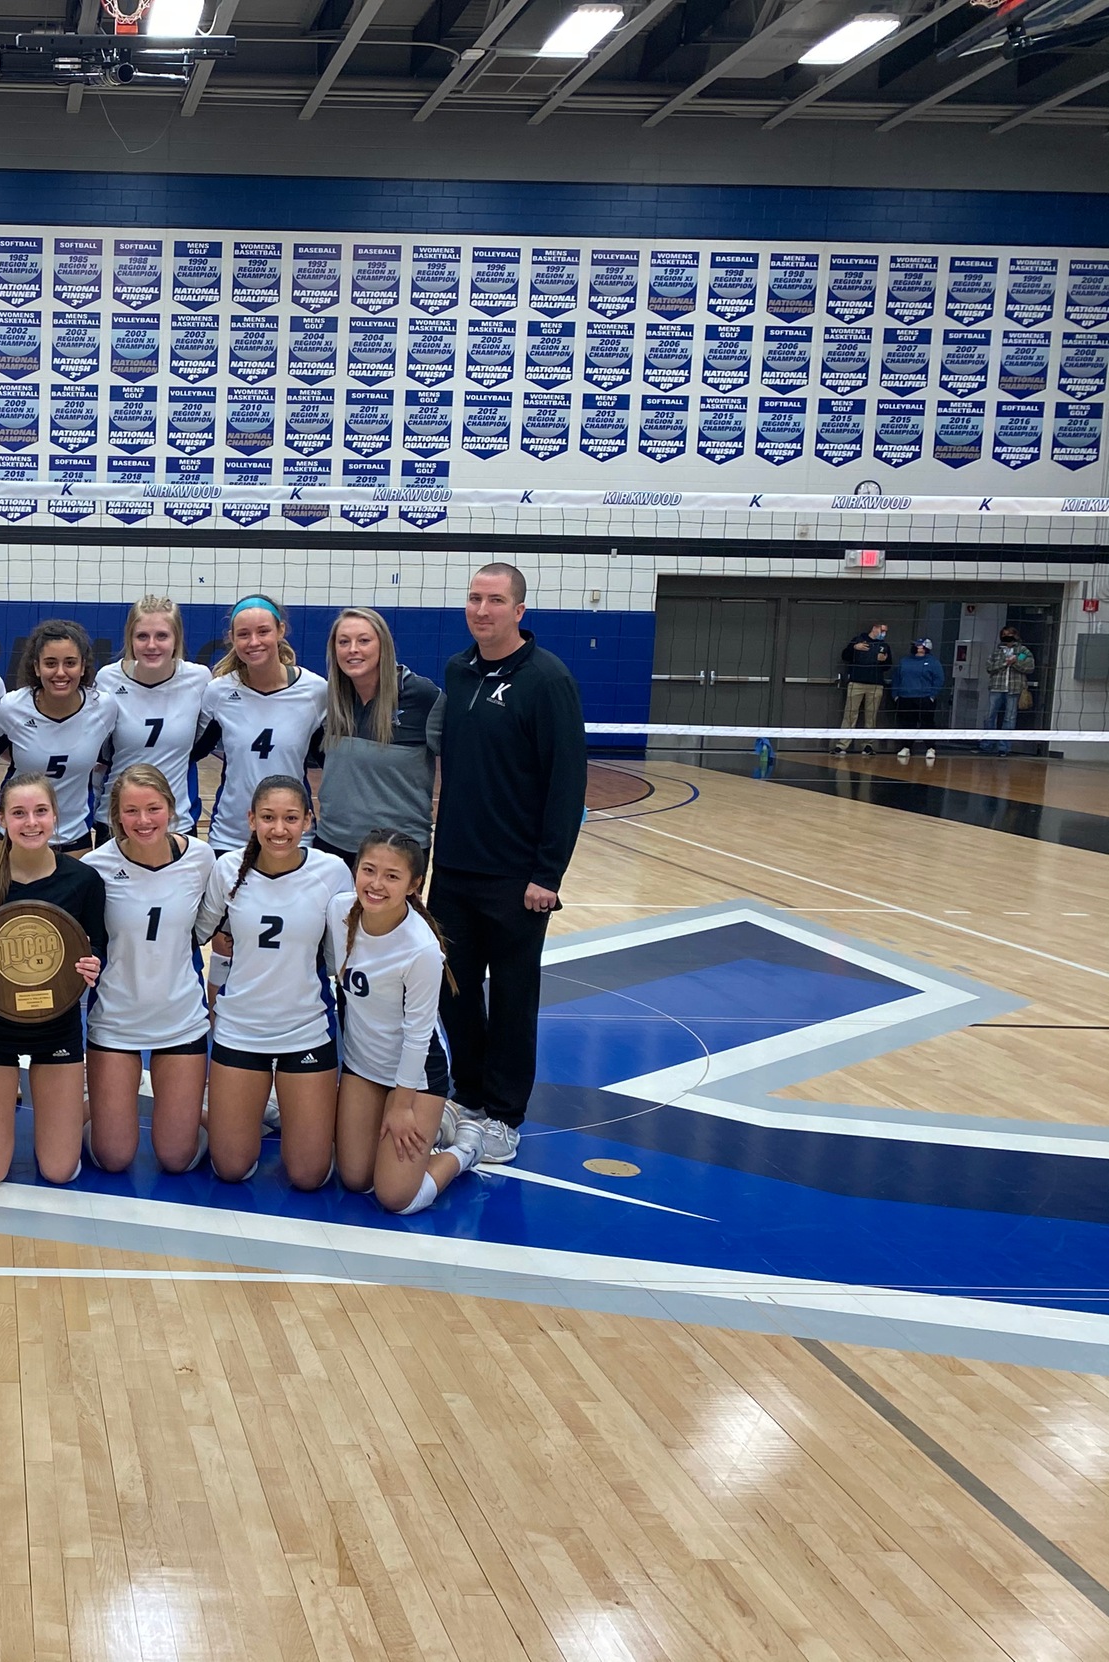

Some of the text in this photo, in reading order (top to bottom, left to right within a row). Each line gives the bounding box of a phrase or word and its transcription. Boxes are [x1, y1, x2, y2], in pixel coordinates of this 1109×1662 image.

[61, 483, 73, 496] K
[143, 485, 221, 499] KIRKWOOD
[290, 487, 302, 501] K
[373, 488, 452, 502] KIRKWOOD
[520, 490, 533, 503] K
[603, 492, 682, 506] KIRKWOOD
[749, 494, 762, 507] K
[831, 495, 911, 509] KIRKWOOD
[978, 497, 992, 510] K
[491, 682, 511, 701] K
[144, 718, 164, 748] 7
[251, 728, 275, 759] 4
[46, 755, 68, 779] 5
[146, 907, 162, 941] 1
[258, 915, 284, 949] 2
[0, 933, 58, 967] NJCAA
[342, 967, 370, 998] 19
